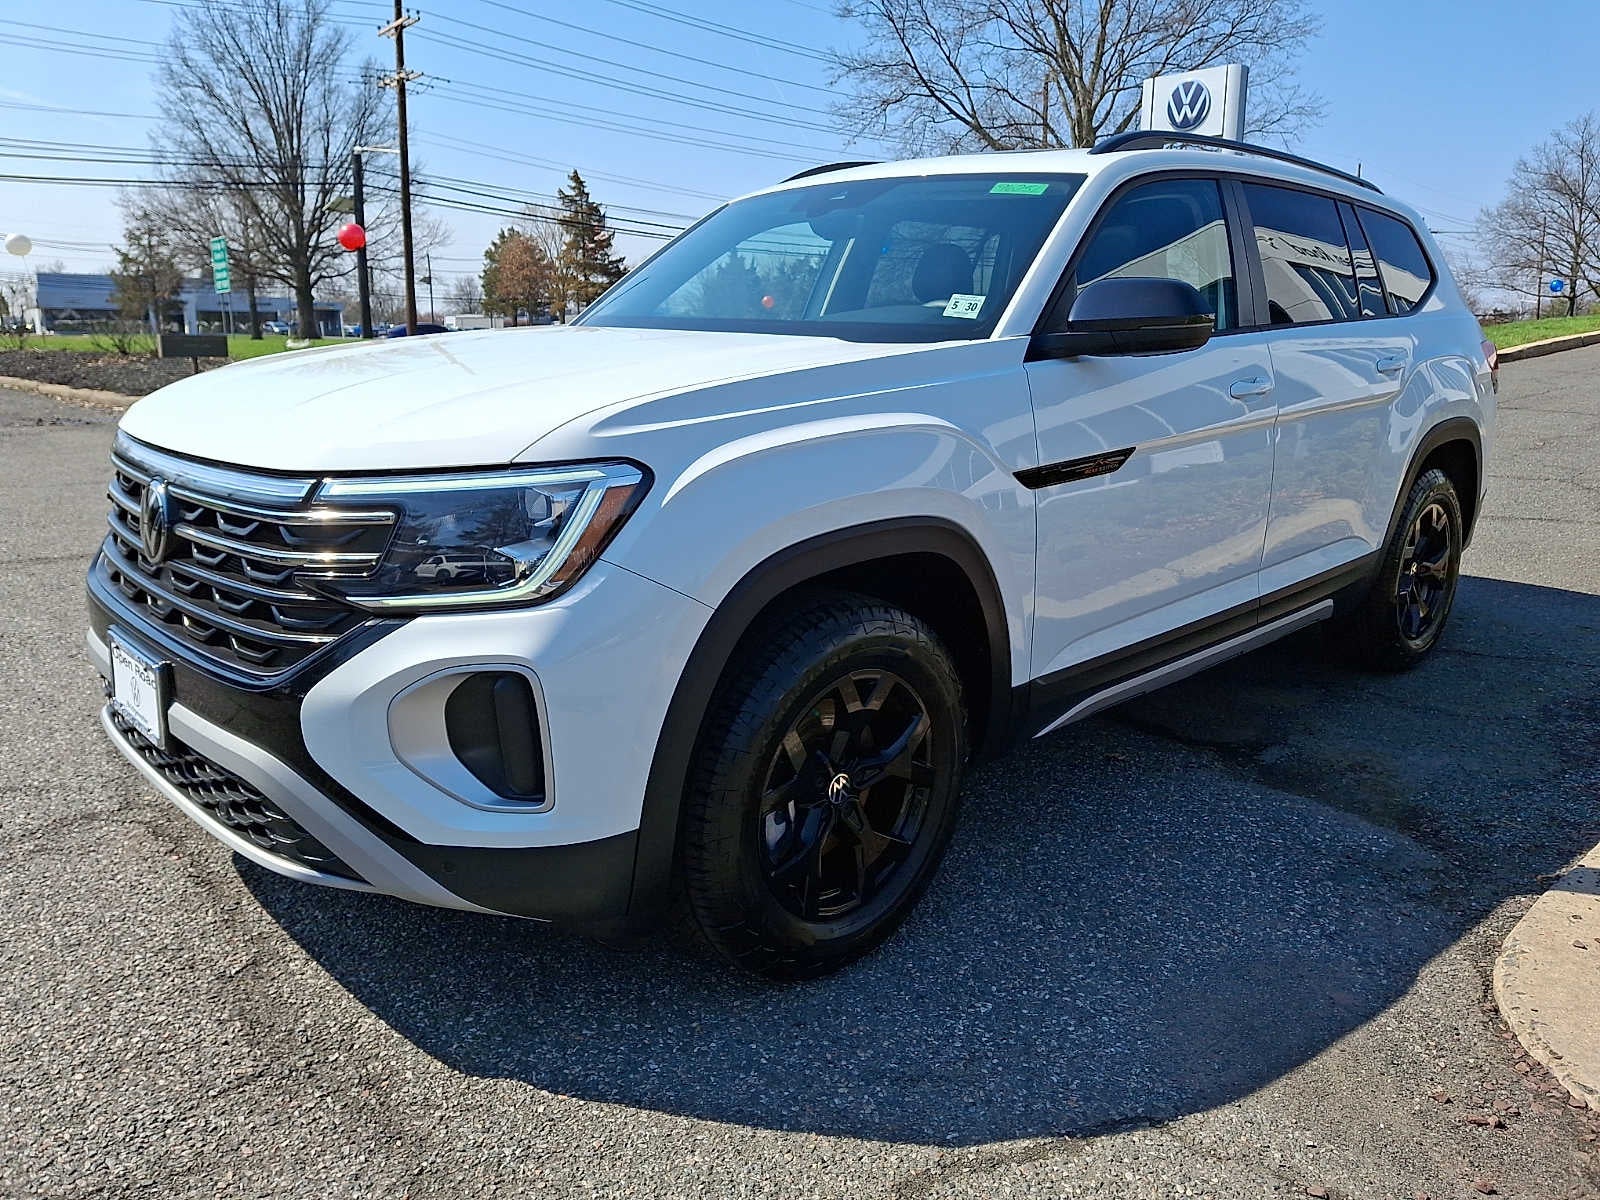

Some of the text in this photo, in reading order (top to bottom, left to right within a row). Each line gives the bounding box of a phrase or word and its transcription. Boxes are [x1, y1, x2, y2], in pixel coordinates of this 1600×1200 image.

[1167, 80, 1211, 131] VW
[951, 300, 978, 312] 5 30
[135, 664, 157, 690] Road
